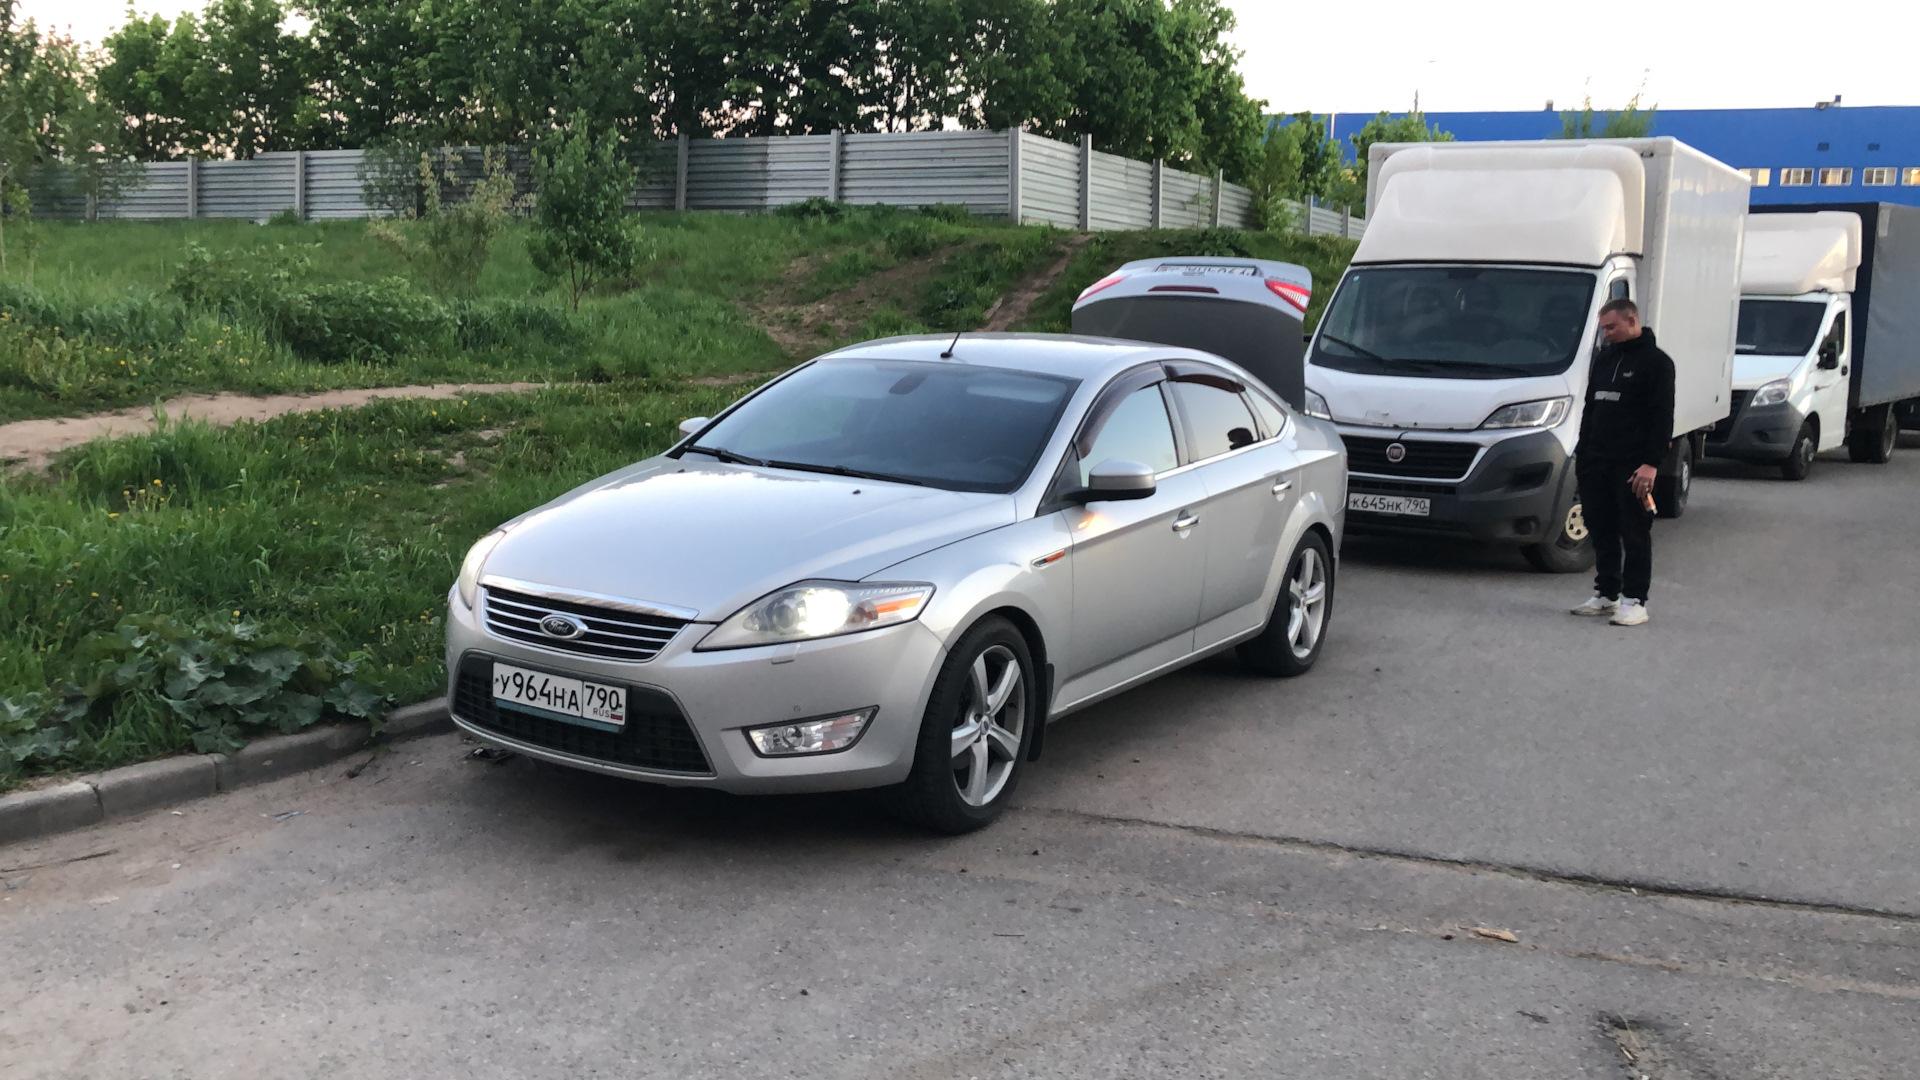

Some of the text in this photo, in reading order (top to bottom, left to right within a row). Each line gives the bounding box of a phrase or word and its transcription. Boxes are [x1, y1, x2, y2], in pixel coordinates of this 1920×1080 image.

[549, 620, 570, 633] Ford
[585, 684, 620, 711] 790
[592, 707, 610, 718] RUS
